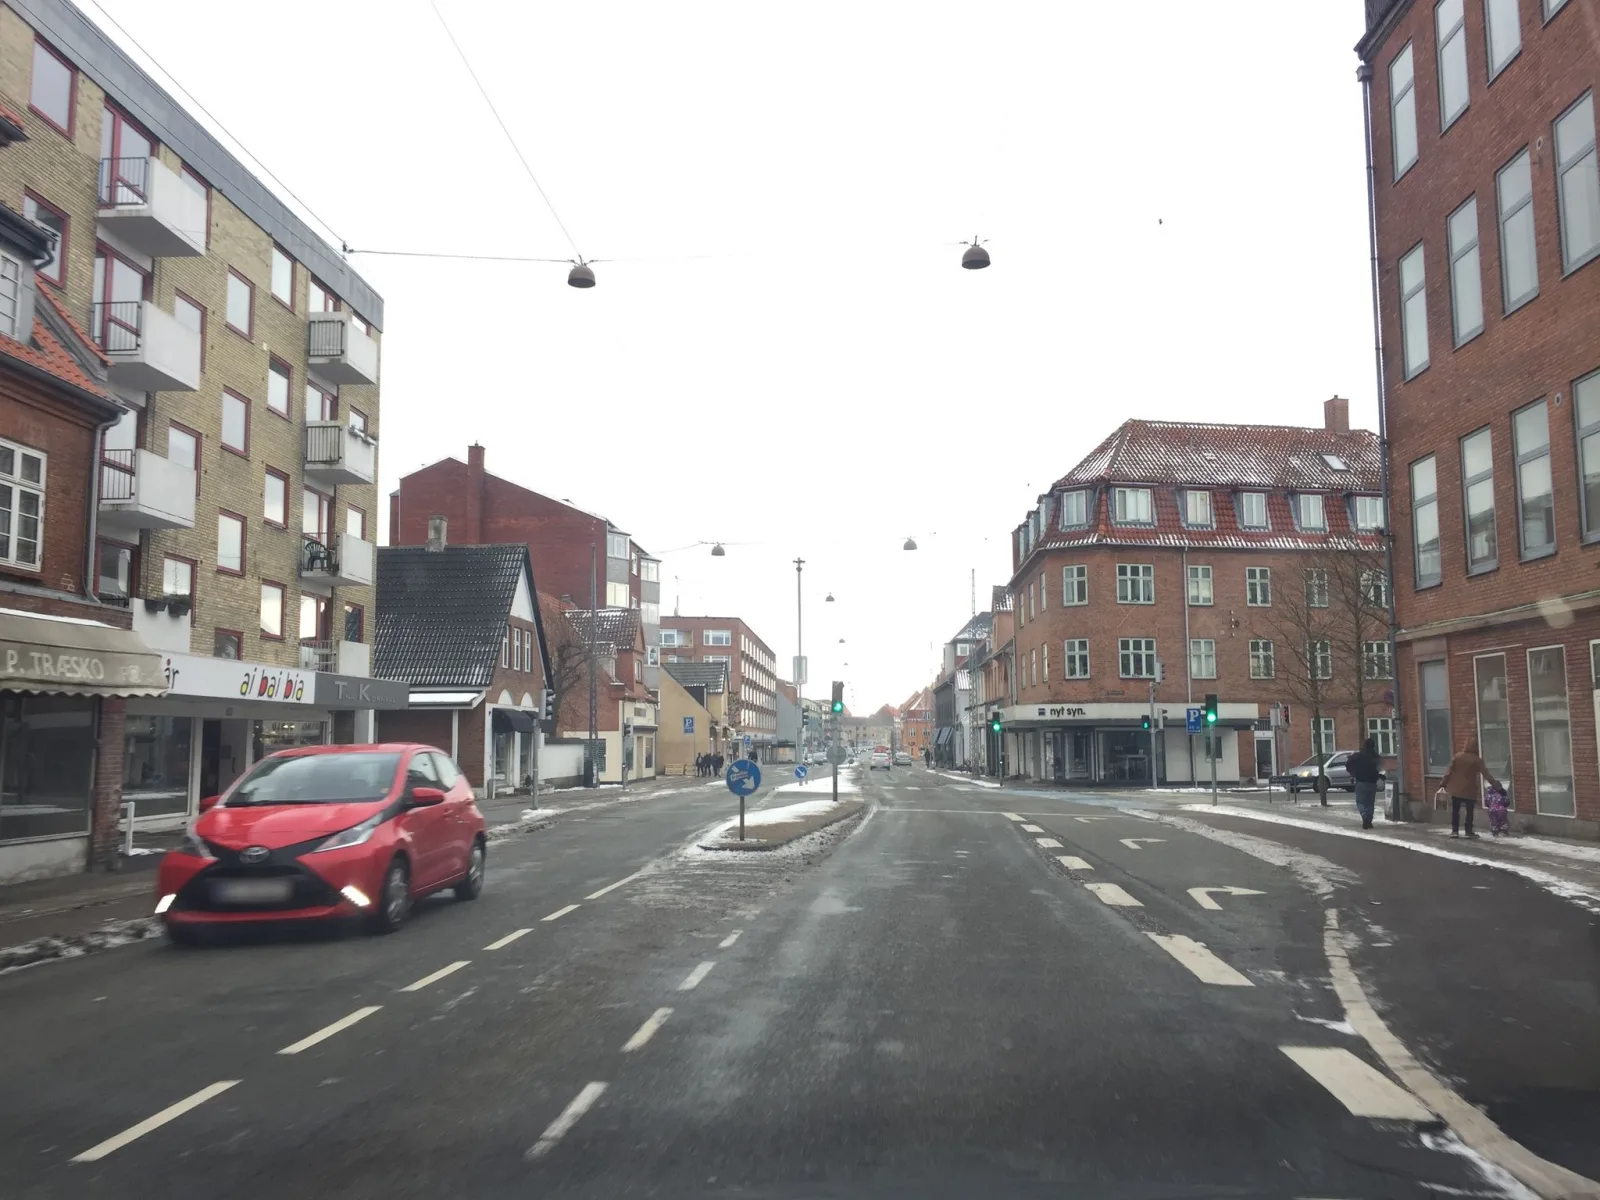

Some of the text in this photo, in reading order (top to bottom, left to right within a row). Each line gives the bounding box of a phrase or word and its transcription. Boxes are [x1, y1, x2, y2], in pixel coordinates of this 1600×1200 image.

[30, 652, 104, 680] TRÆSKO
[240, 667, 305, 701] ai bai bia
[1050, 706, 1086, 717] nyt syn.
[1189, 710, 1199, 722] P
[685, 718, 693, 727] P
